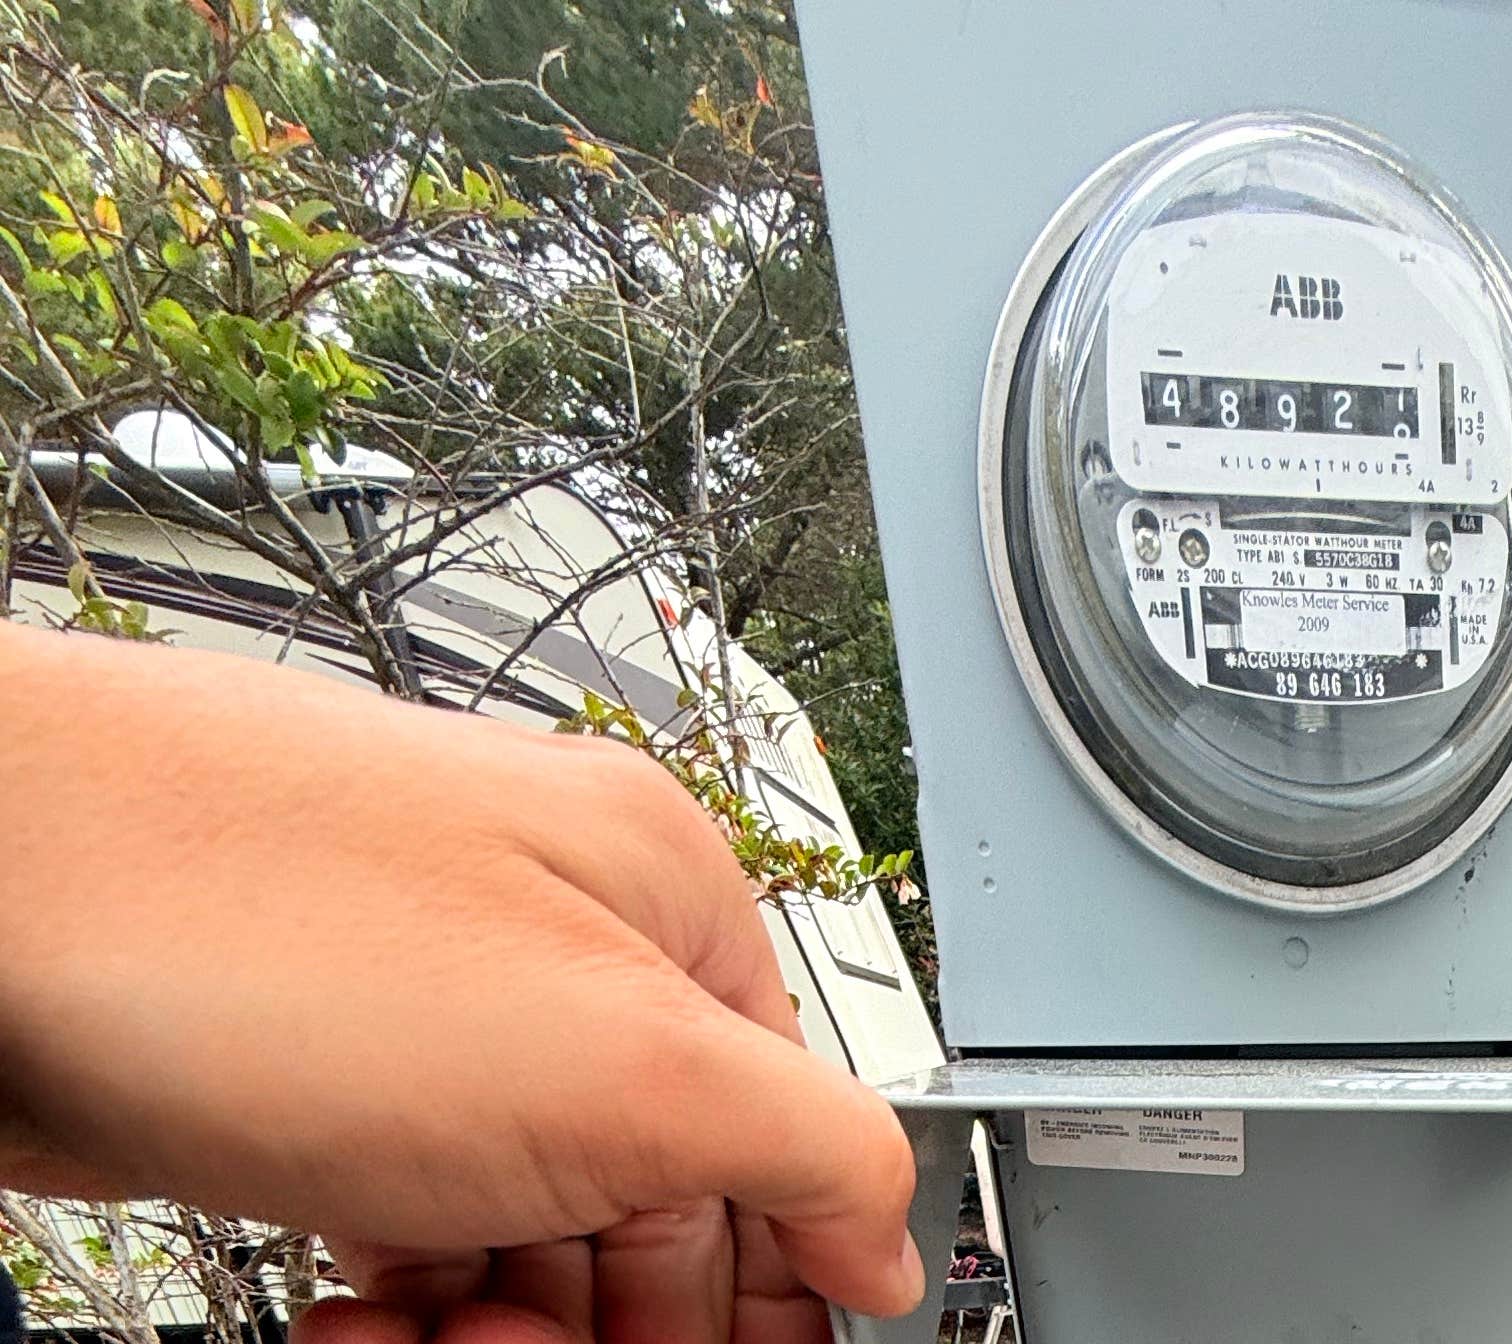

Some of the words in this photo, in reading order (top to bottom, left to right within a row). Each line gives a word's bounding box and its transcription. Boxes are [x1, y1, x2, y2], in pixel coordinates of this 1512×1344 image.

[1270, 274, 1343, 320] ABB
[1418, 479, 1435, 493] 4A
[1491, 480, 1499, 493] 2
[1459, 517, 1477, 531] 4A
[1233, 533, 1310, 547] SINGLE-STATOR
[1314, 536, 1369, 548] WATTHOUR
[1373, 539, 1403, 550] METER
[1237, 548, 1263, 563] TYPE
[1136, 567, 1165, 582] FORM
[1204, 568, 1226, 584] 200
[1231, 570, 1244, 585] CL
[1298, 574, 1306, 586] V
[1326, 572, 1333, 587] 3
[1339, 575, 1348, 587] W
[1365, 573, 1380, 589] 60
[1409, 578, 1425, 591] TA
[1430, 576, 1444, 592] 30
[1148, 601, 1180, 618] ABB
[1242, 591, 1298, 608] Knowles
[1301, 594, 1341, 610] Meter
[1343, 596, 1390, 612] Service
[1298, 616, 1330, 632] 2009
[1460, 614, 1488, 625] MADE
[1468, 625, 1480, 635] IN
[1276, 671, 1298, 696] 89
[1354, 671, 1385, 697] 183
